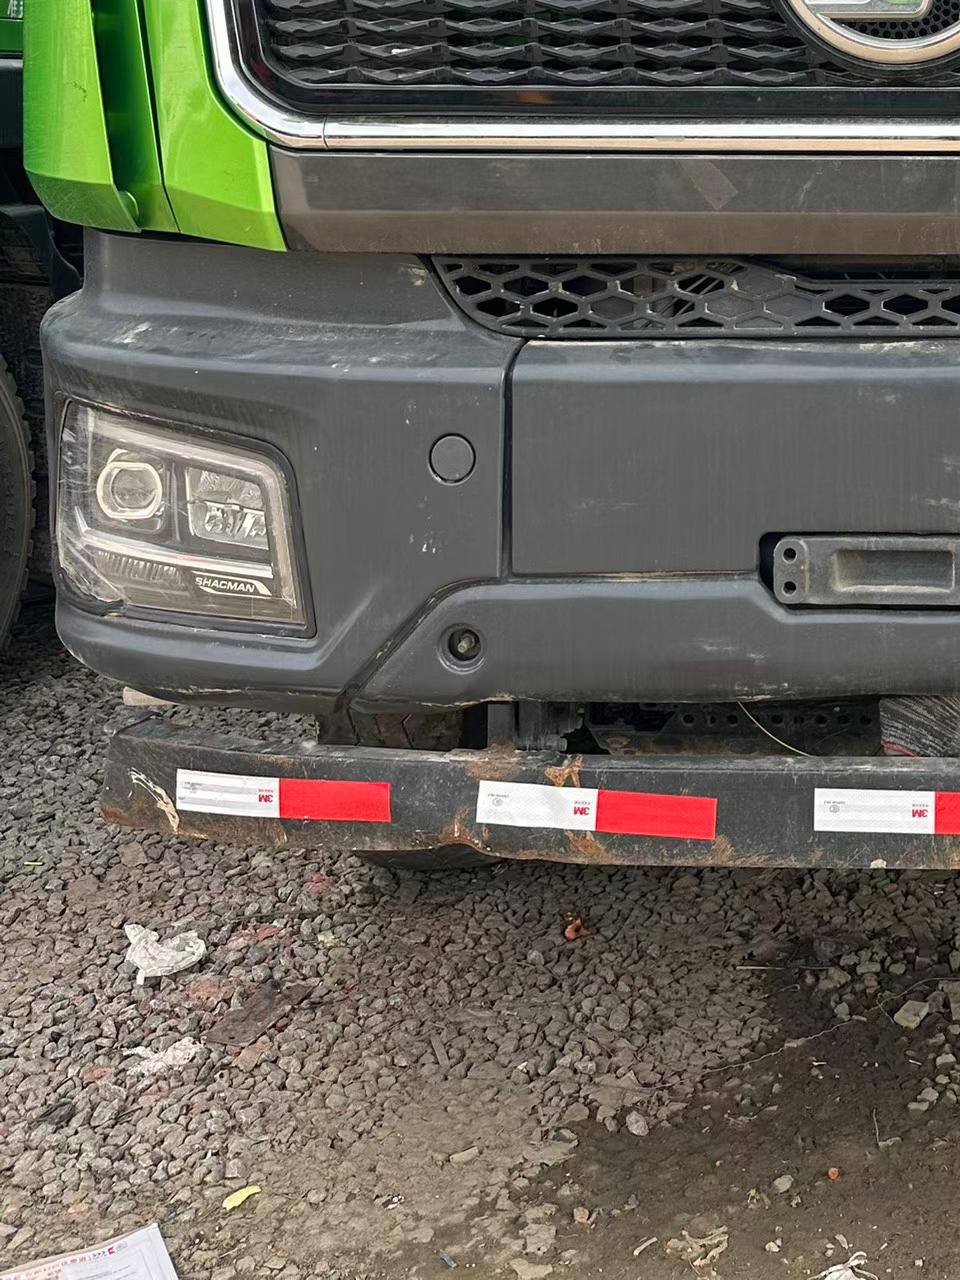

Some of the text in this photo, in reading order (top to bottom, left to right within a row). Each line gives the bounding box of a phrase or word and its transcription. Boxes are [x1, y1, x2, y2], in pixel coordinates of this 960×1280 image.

[195, 576, 255, 593] SHACMAN
[258, 793, 274, 803] 3M
[573, 806, 590, 816] 3M
[911, 809, 929, 818] 3M
